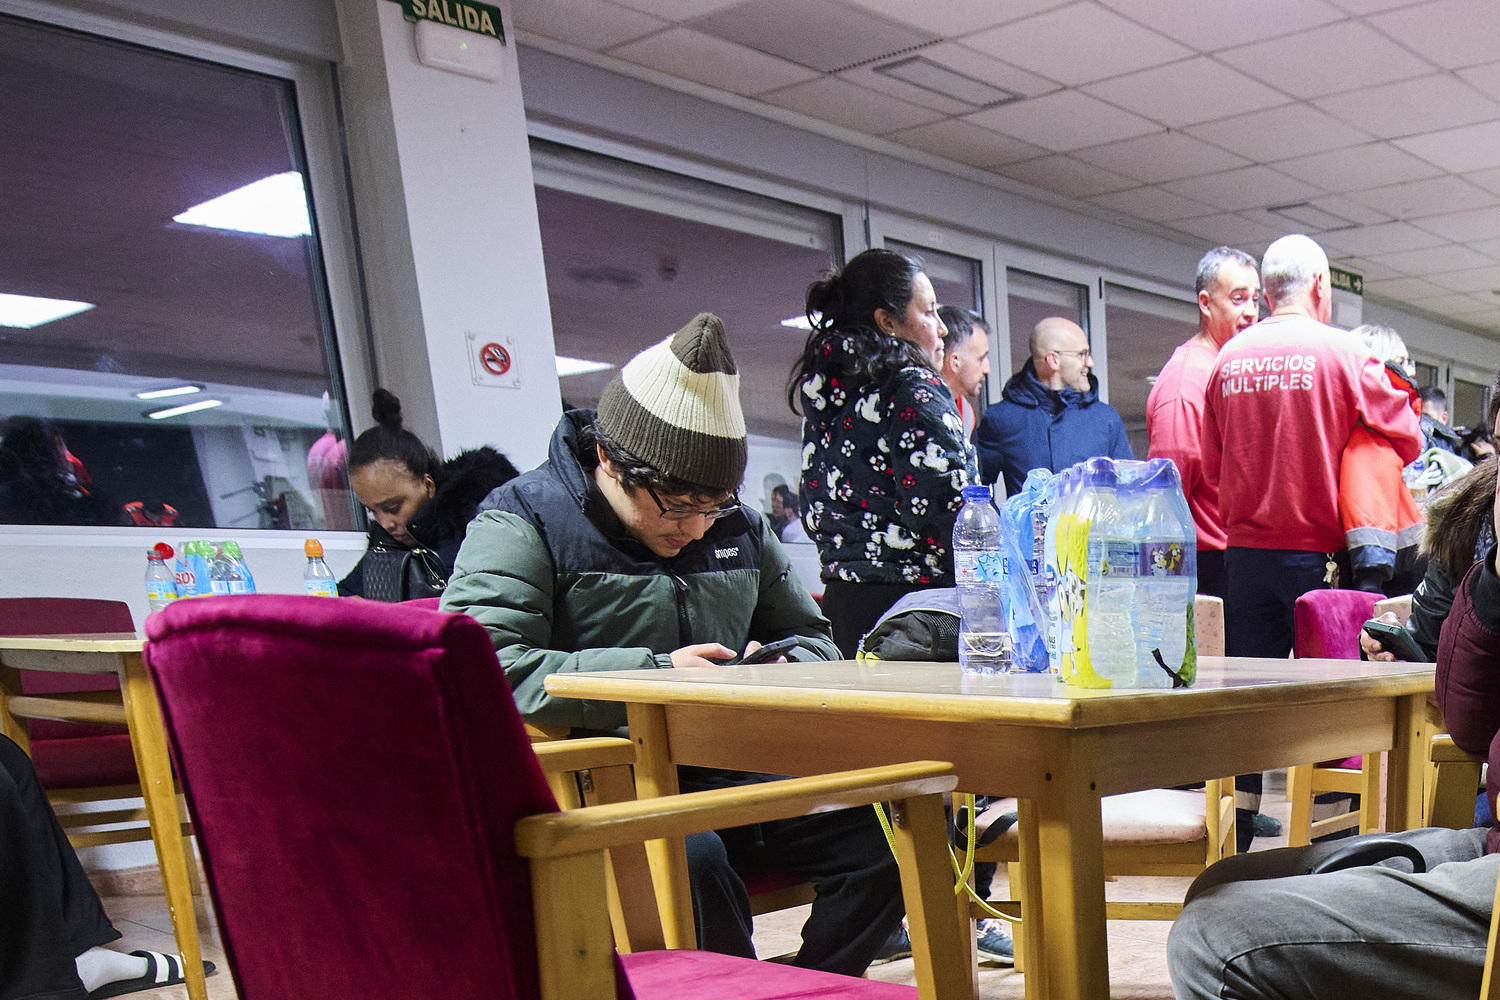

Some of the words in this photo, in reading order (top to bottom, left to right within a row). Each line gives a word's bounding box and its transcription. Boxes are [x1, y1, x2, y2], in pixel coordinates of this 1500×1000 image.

[412, 0, 496, 36] SALIDA
[1221, 354, 1316, 379] SERVICIOS
[1221, 373, 1313, 398] MULTIPLES
